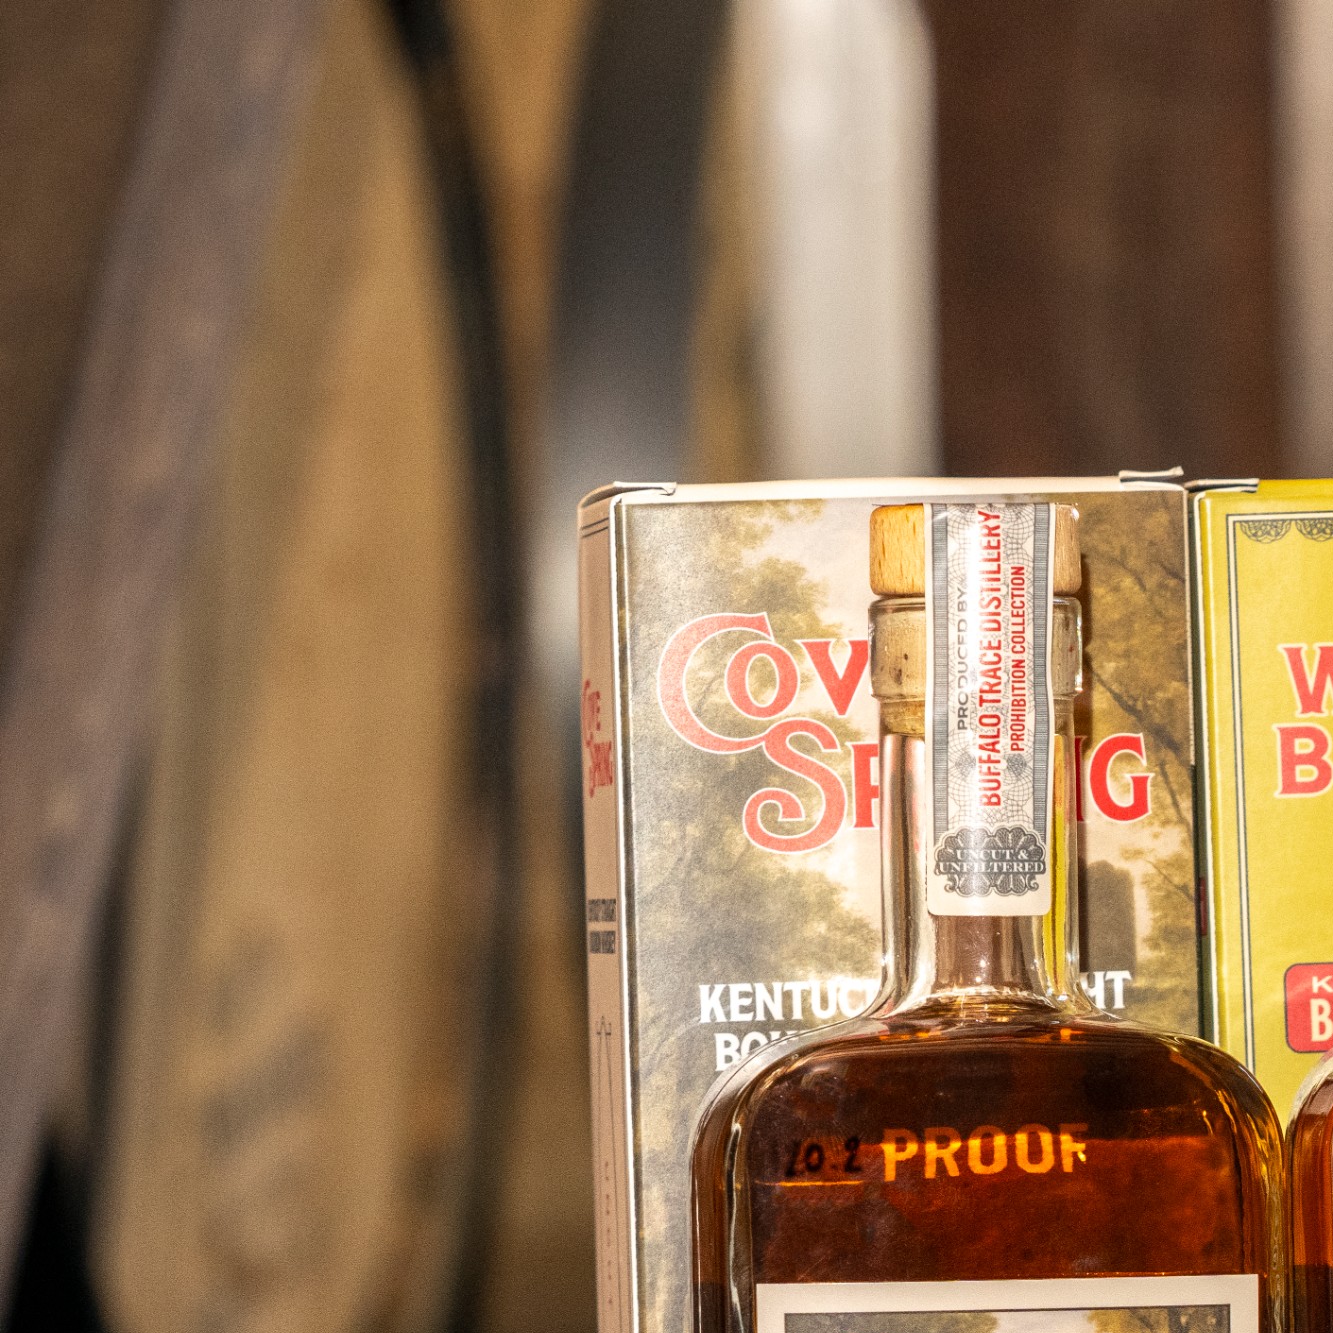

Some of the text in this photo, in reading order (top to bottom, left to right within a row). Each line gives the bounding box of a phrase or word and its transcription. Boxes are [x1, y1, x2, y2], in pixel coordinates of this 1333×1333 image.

[978, 511, 1002, 807] BUFFALO TRACE DISTILLERY
[1011, 566, 1025, 751] PROHIBITION COLLECTION
[940, 862, 1044, 872] UNFILTERED
[957, 850, 1015, 860] UNCUT
[882, 1122, 1089, 1182] PROOF
